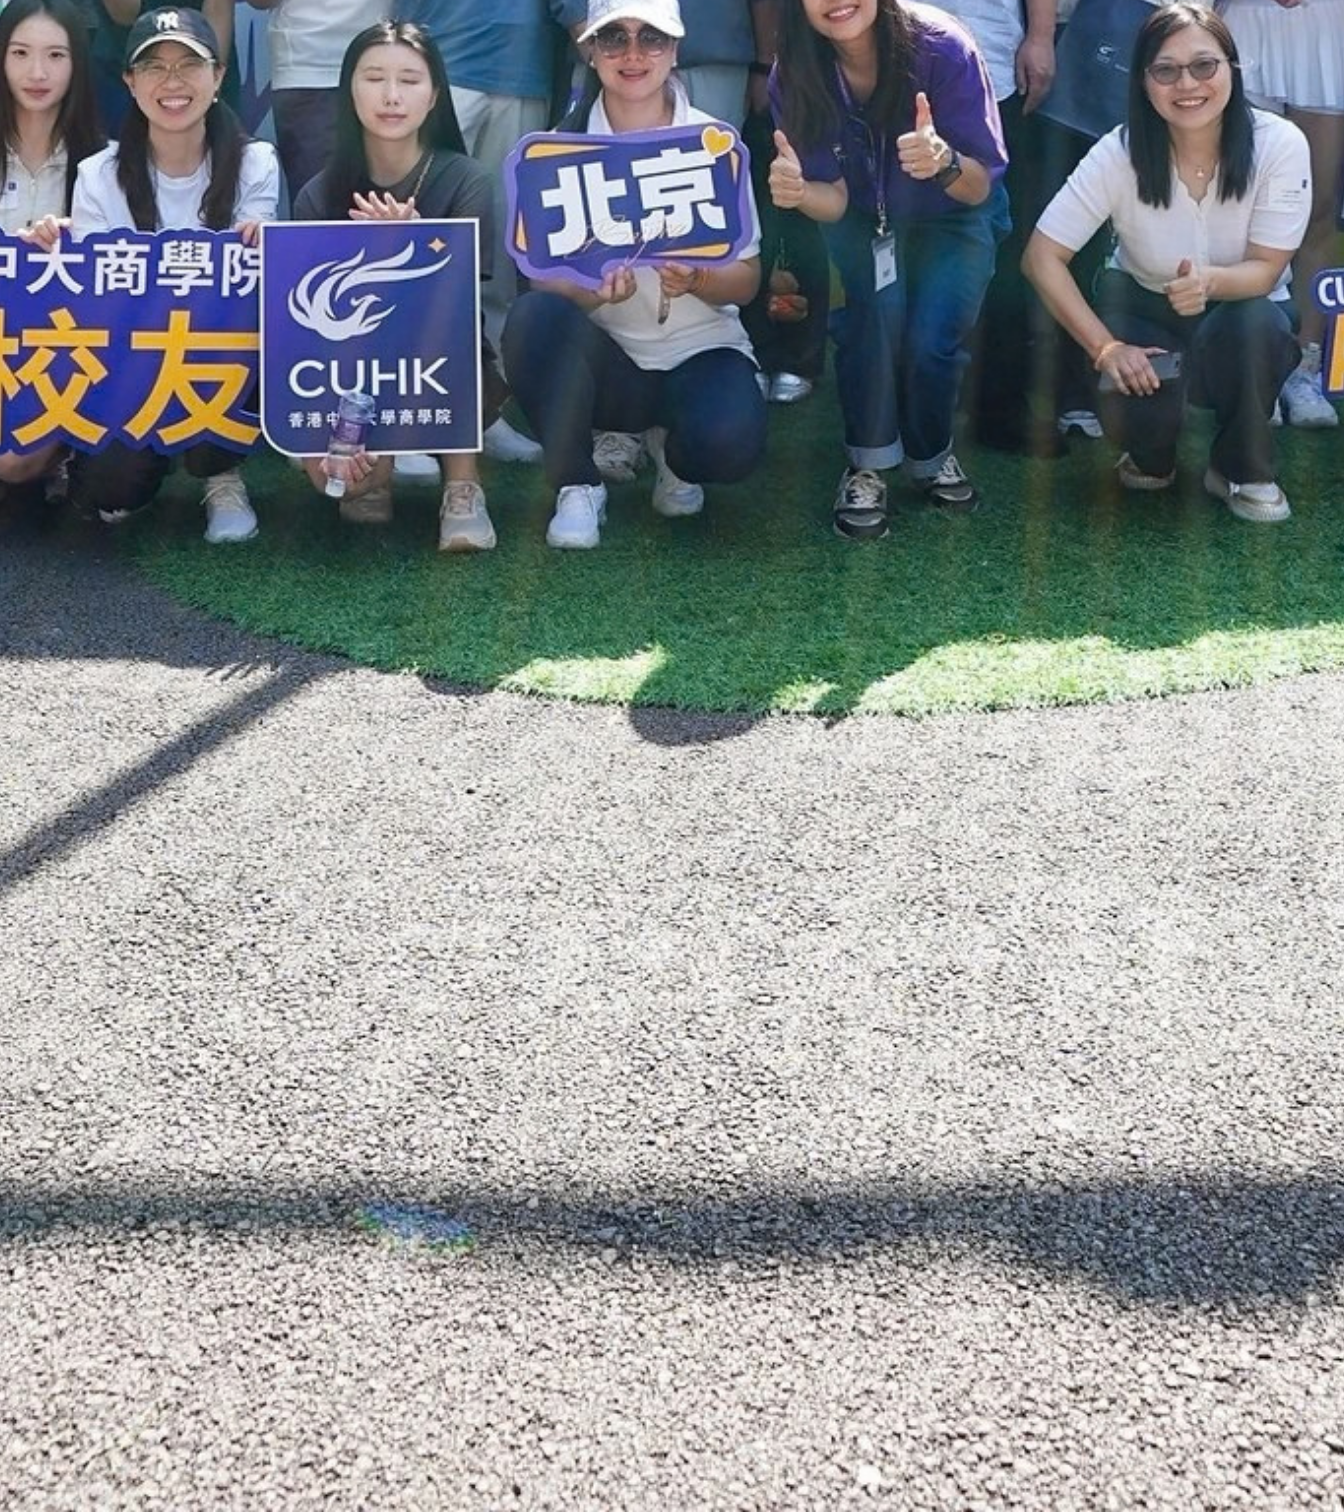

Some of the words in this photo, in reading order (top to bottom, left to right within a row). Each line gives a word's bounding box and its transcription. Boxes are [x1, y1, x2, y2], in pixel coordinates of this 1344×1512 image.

[540, 147, 727, 257] 北京
[289, 357, 449, 398] CUHK
[288, 408, 452, 429] 香港中學商學院
